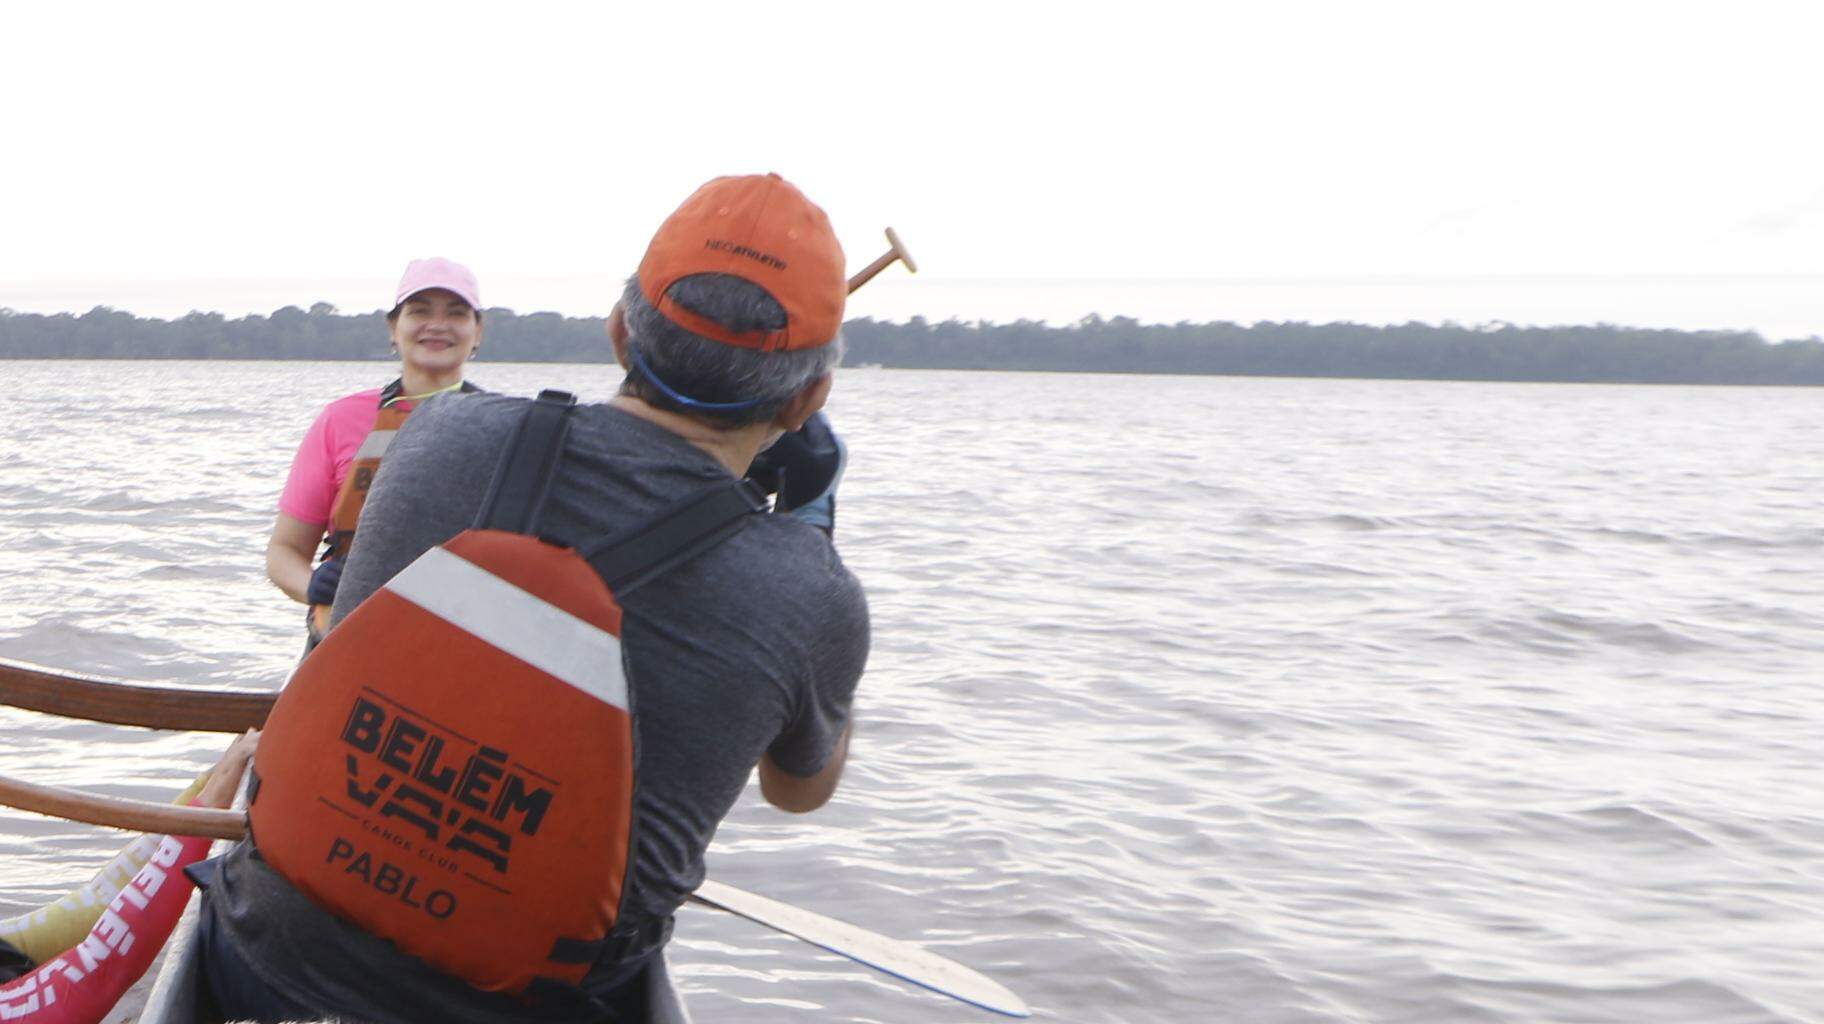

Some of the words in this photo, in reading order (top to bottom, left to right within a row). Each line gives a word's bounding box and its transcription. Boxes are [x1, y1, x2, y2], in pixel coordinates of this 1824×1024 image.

[341, 695, 555, 837] BELÉM
[346, 753, 513, 875] VA'A
[326, 837, 458, 919] PABLO
